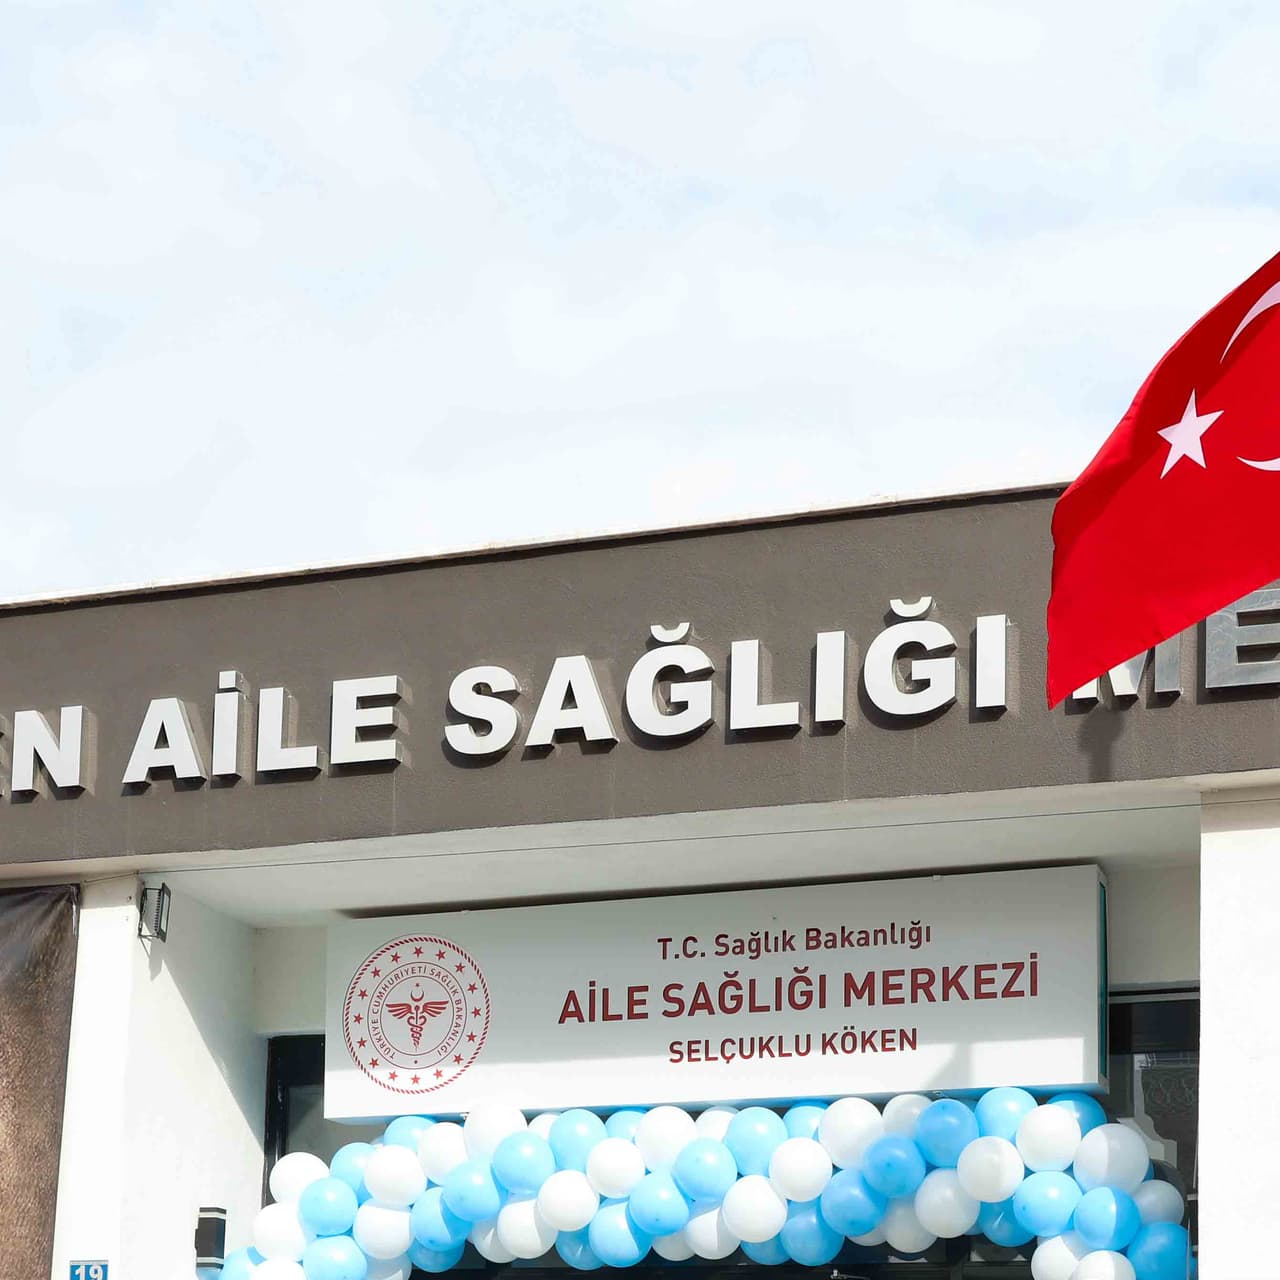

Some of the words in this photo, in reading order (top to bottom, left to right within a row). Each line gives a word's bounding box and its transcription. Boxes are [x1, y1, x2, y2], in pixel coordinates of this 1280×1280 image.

[122, 670, 402, 784] AİLE
[443, 596, 1008, 756] SAĞLIĞI
[657, 936, 706, 961] T.C.
[714, 930, 797, 961] Sağlık
[805, 920, 932, 951] Bakanlığı
[371, 1018, 396, 1060] TÜRKİYE
[429, 967, 459, 997] SAĞLIK
[558, 980, 649, 1024] AİLE
[662, 966, 827, 1018] SAĞLIĞI
[843, 952, 1038, 1008] MERKEZİ
[669, 1033, 812, 1064] SELÇUKLU
[821, 1025, 918, 1056] KÖKEN
